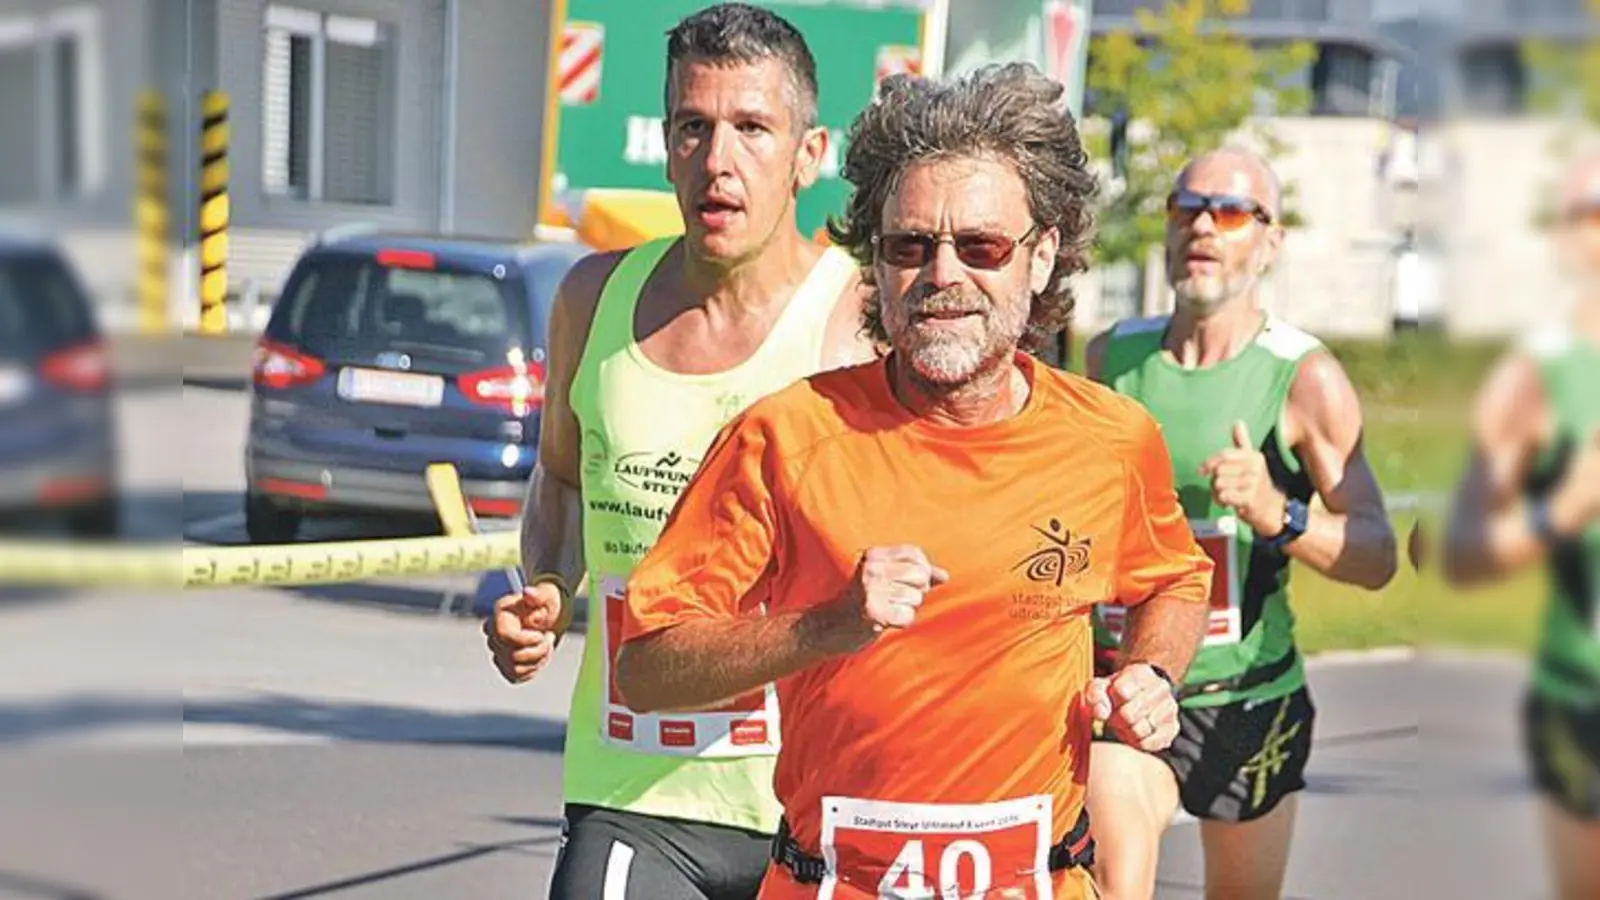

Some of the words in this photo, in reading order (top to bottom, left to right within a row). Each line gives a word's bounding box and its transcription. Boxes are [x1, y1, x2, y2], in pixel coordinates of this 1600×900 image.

[614, 463, 694, 482] LAUFWUN
[642, 481, 684, 495] STEY
[878, 839, 992, 900] 40
